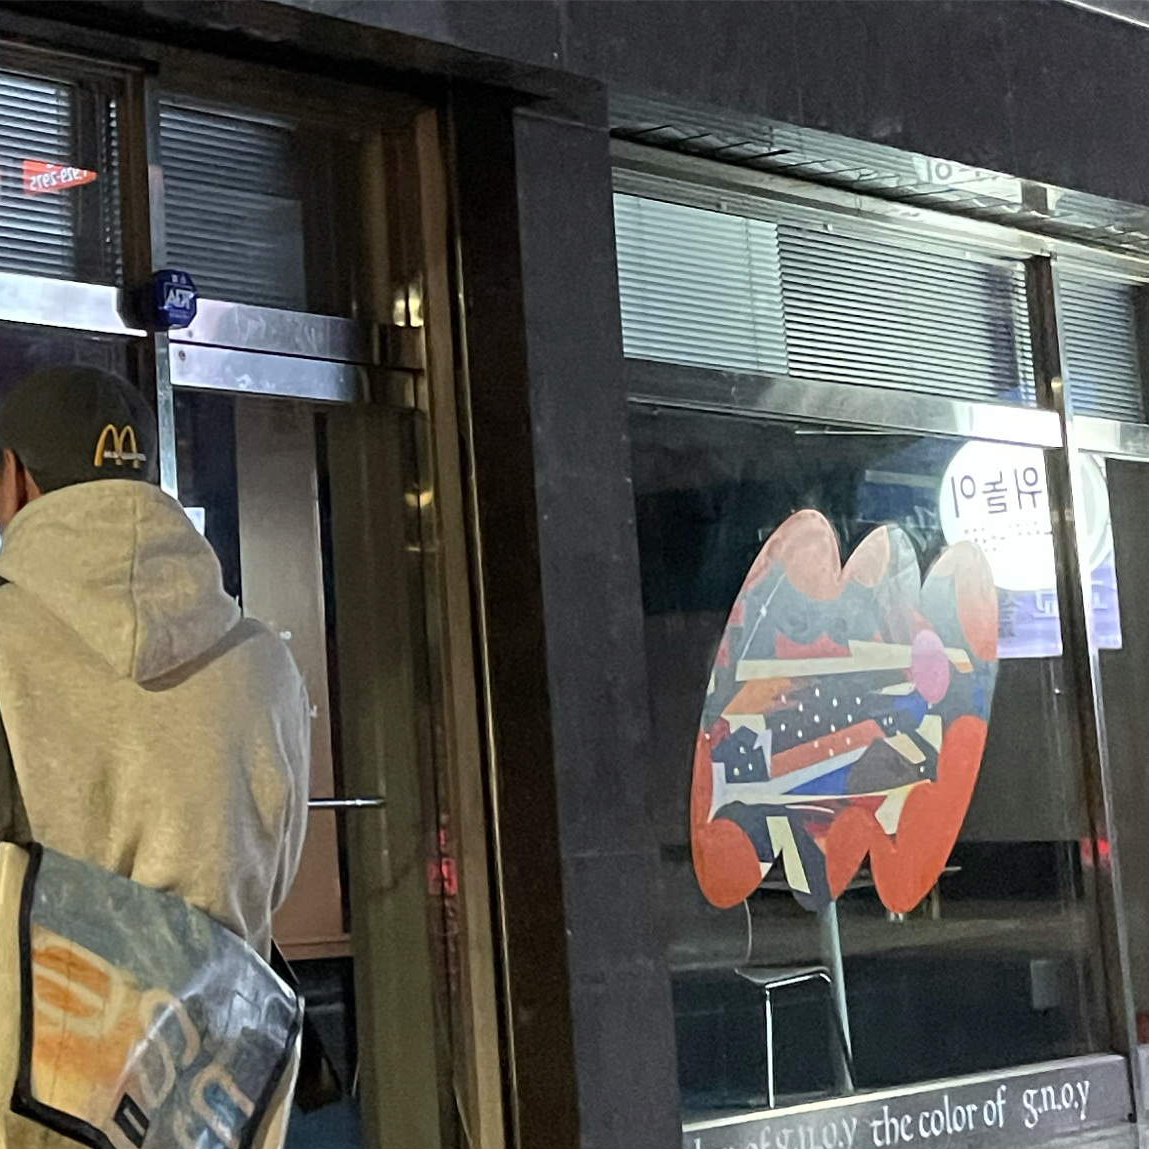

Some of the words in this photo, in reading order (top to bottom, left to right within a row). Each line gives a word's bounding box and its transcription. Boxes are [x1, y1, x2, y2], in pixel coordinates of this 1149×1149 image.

[869, 1105, 915, 1147] the
[918, 1094, 978, 1138] color
[983, 1084, 1007, 1128] of
